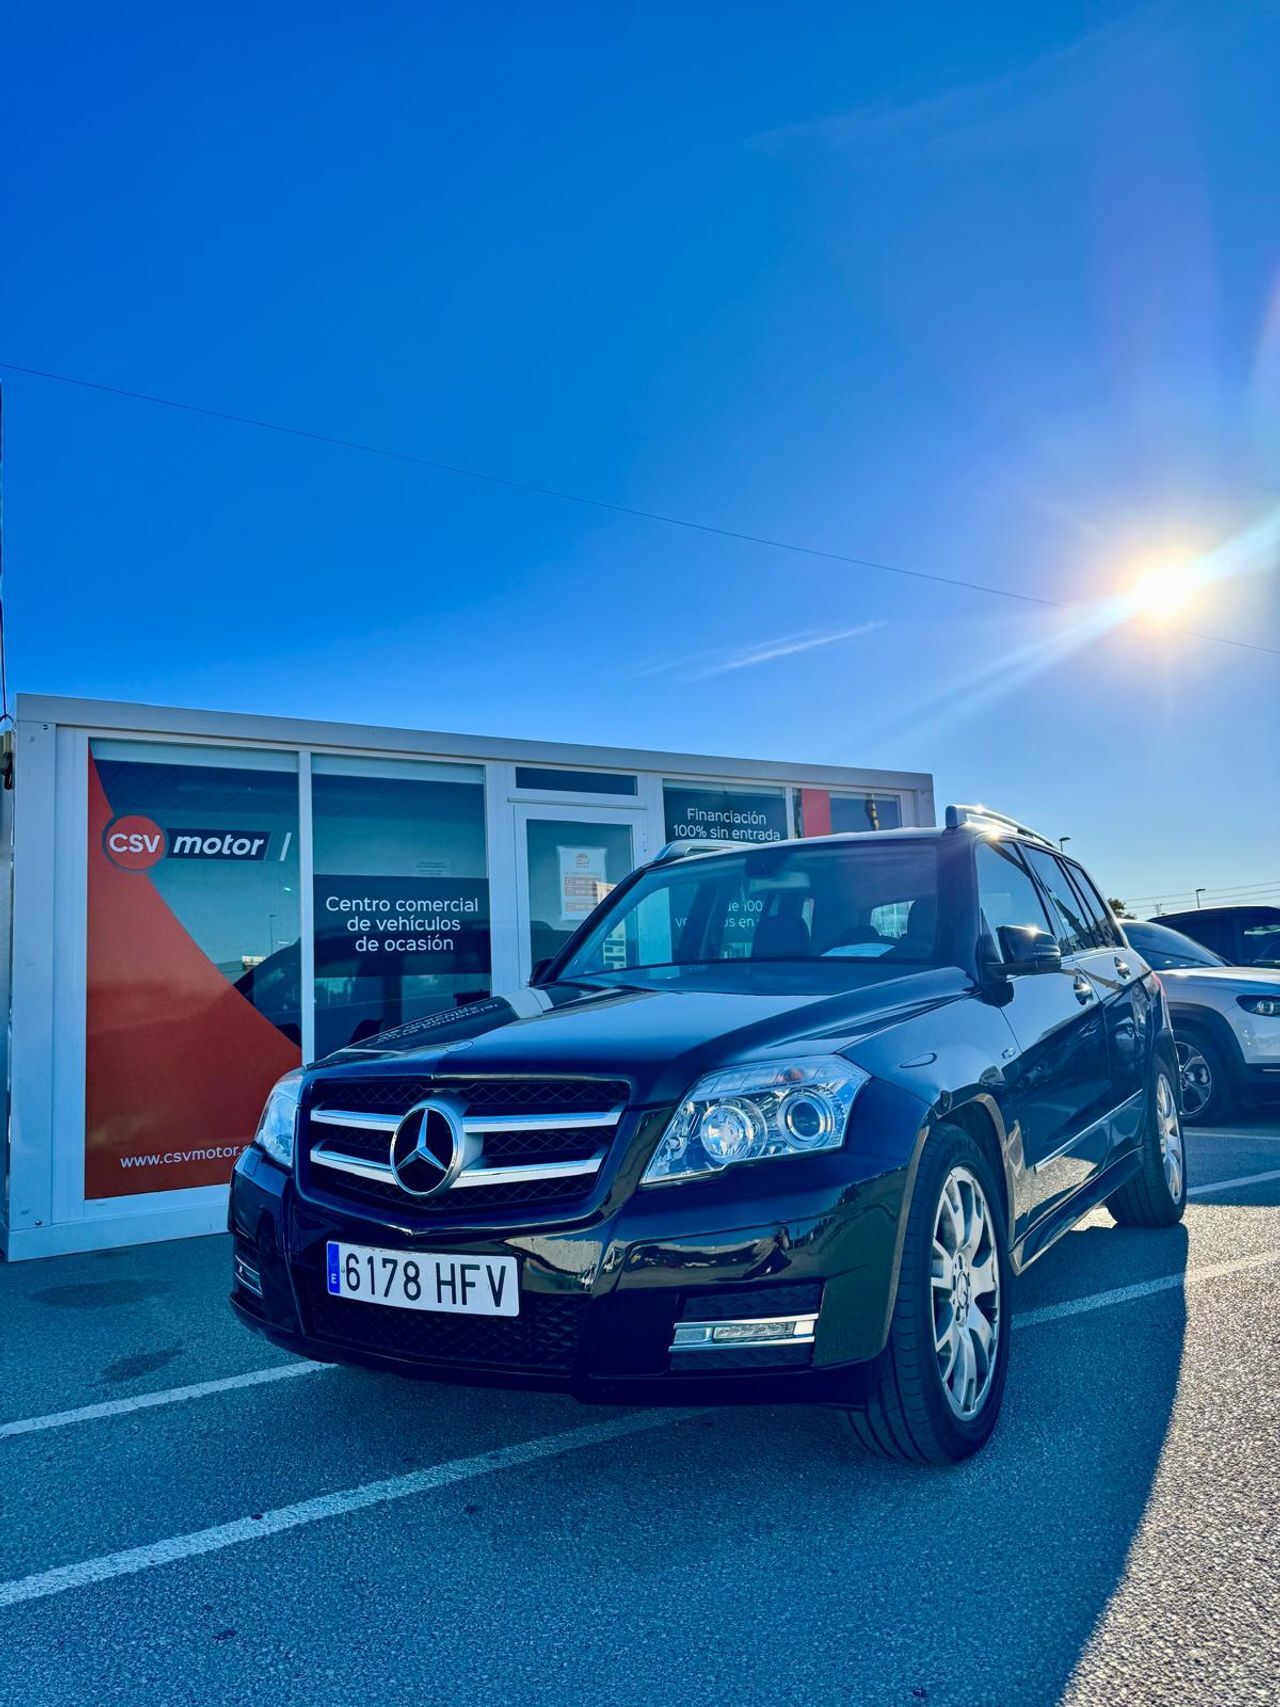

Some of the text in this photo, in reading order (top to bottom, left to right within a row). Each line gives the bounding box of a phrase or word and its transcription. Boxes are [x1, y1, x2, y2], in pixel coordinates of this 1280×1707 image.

[687, 808, 767, 825] Financiación
[673, 825, 781, 841] 100% sin entrada
[109, 833, 264, 856] CSV motor
[326, 896, 479, 912] Centro comercial
[347, 915, 461, 931] de vehículos
[355, 934, 454, 952] de ocasión
[331, 1253, 506, 1308] E 6178 HFV
